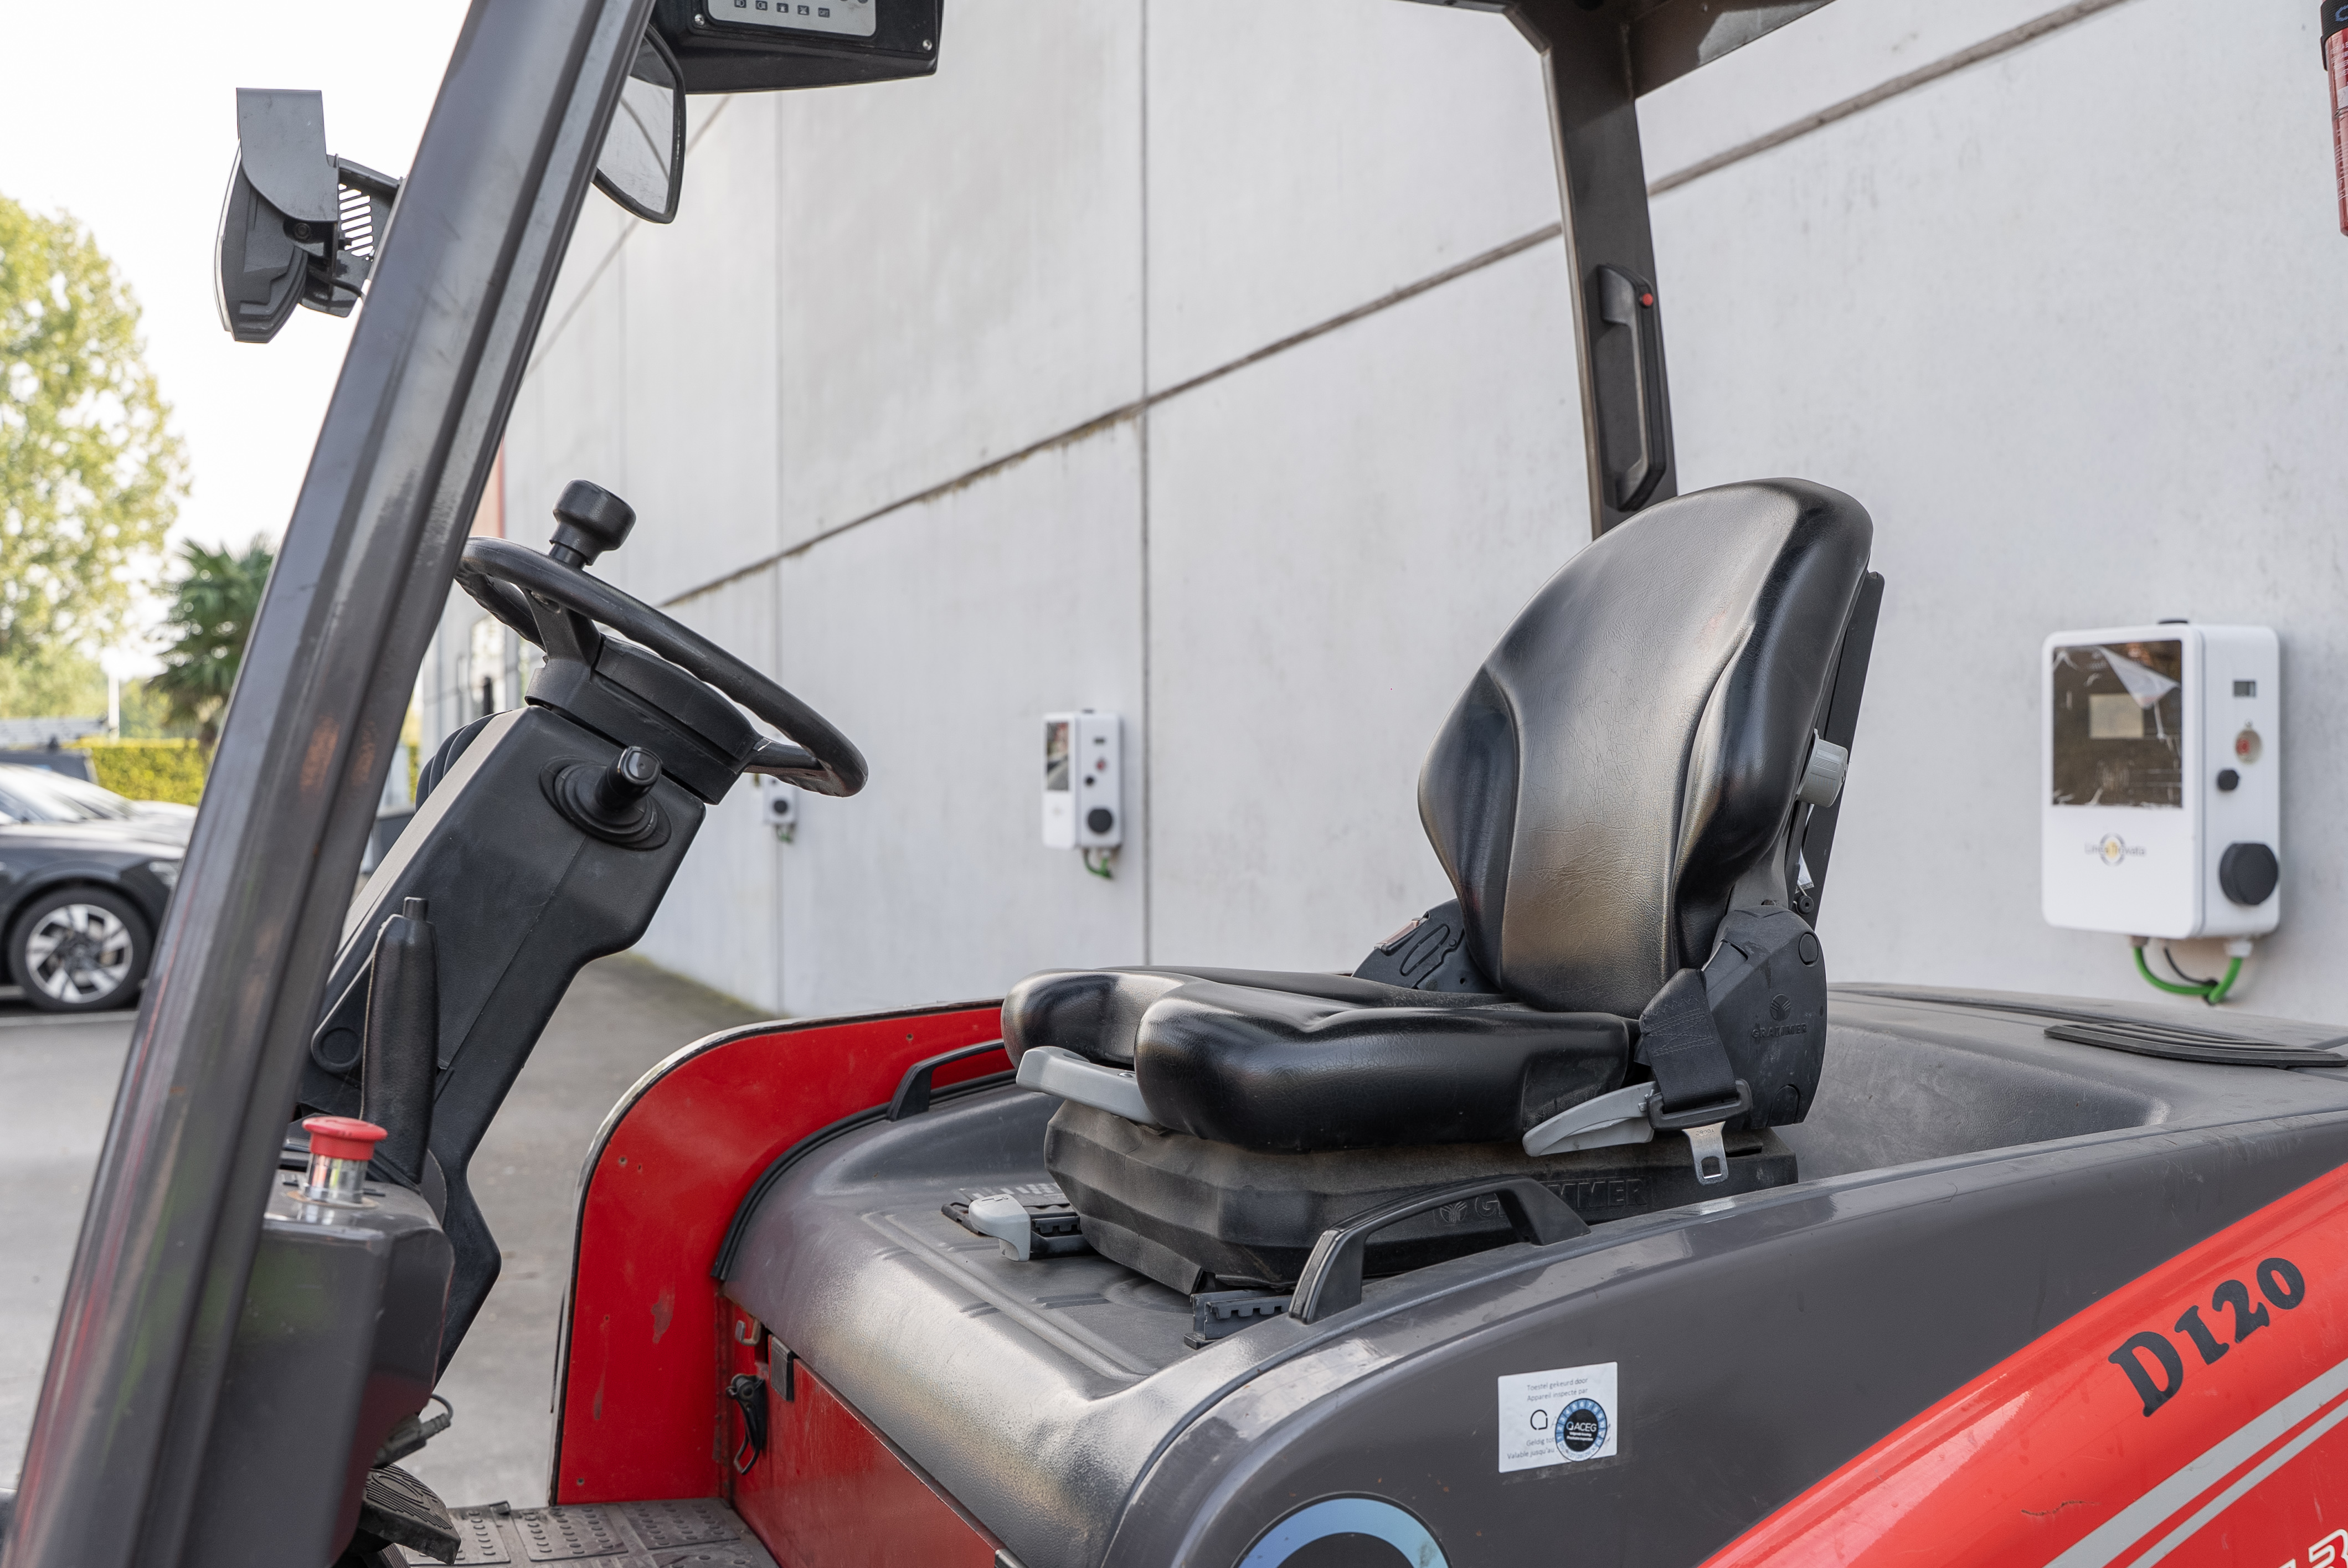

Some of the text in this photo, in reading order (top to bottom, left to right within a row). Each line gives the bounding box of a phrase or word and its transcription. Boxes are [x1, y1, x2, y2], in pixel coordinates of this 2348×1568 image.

[1752, 1023, 1807, 1039] GRAMMER
[1475, 1179, 1647, 1218] GMMER
[1527, 1382, 1548, 1391] Toestel
[1549, 1379, 1573, 1390] gekeurd
[1527, 1388, 1588, 1401] Appareil inspecté par
[1573, 1422, 1597, 1432] ACEG
[1526, 1438, 1544, 1447] Geldig
[1507, 1448, 1554, 1459] Valable jusqu'au
